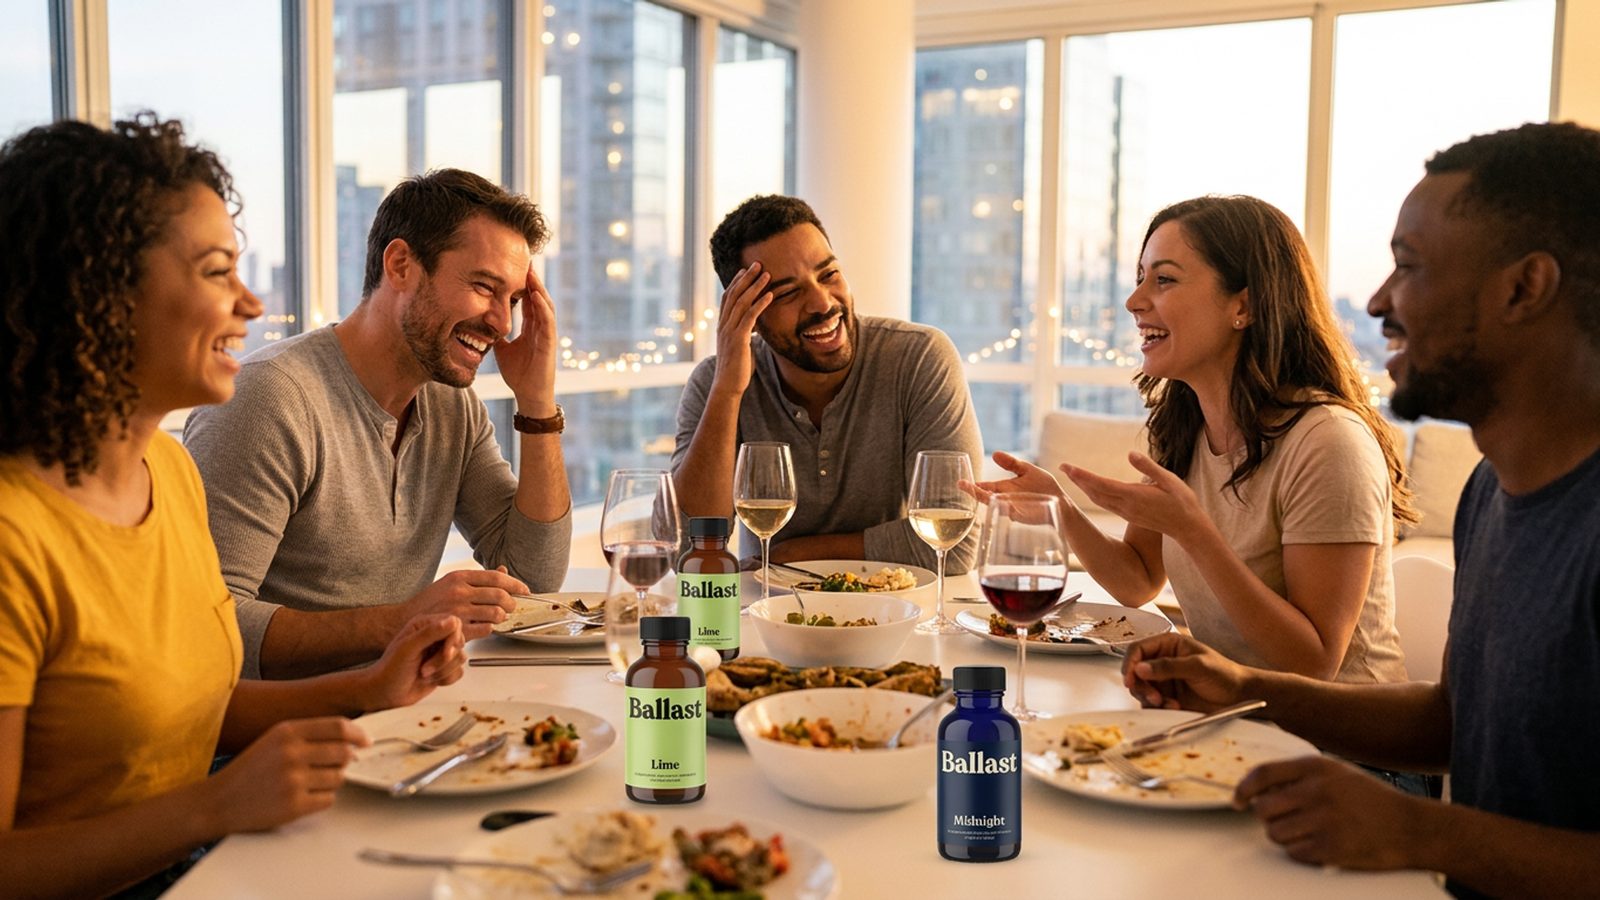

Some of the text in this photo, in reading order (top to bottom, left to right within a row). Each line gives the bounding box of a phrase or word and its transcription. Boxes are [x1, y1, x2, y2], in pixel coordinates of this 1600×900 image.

[681, 580, 737, 598] Ballast
[629, 697, 702, 720] Ballast
[651, 759, 680, 770] Lime
[942, 750, 1018, 774] Ballast
